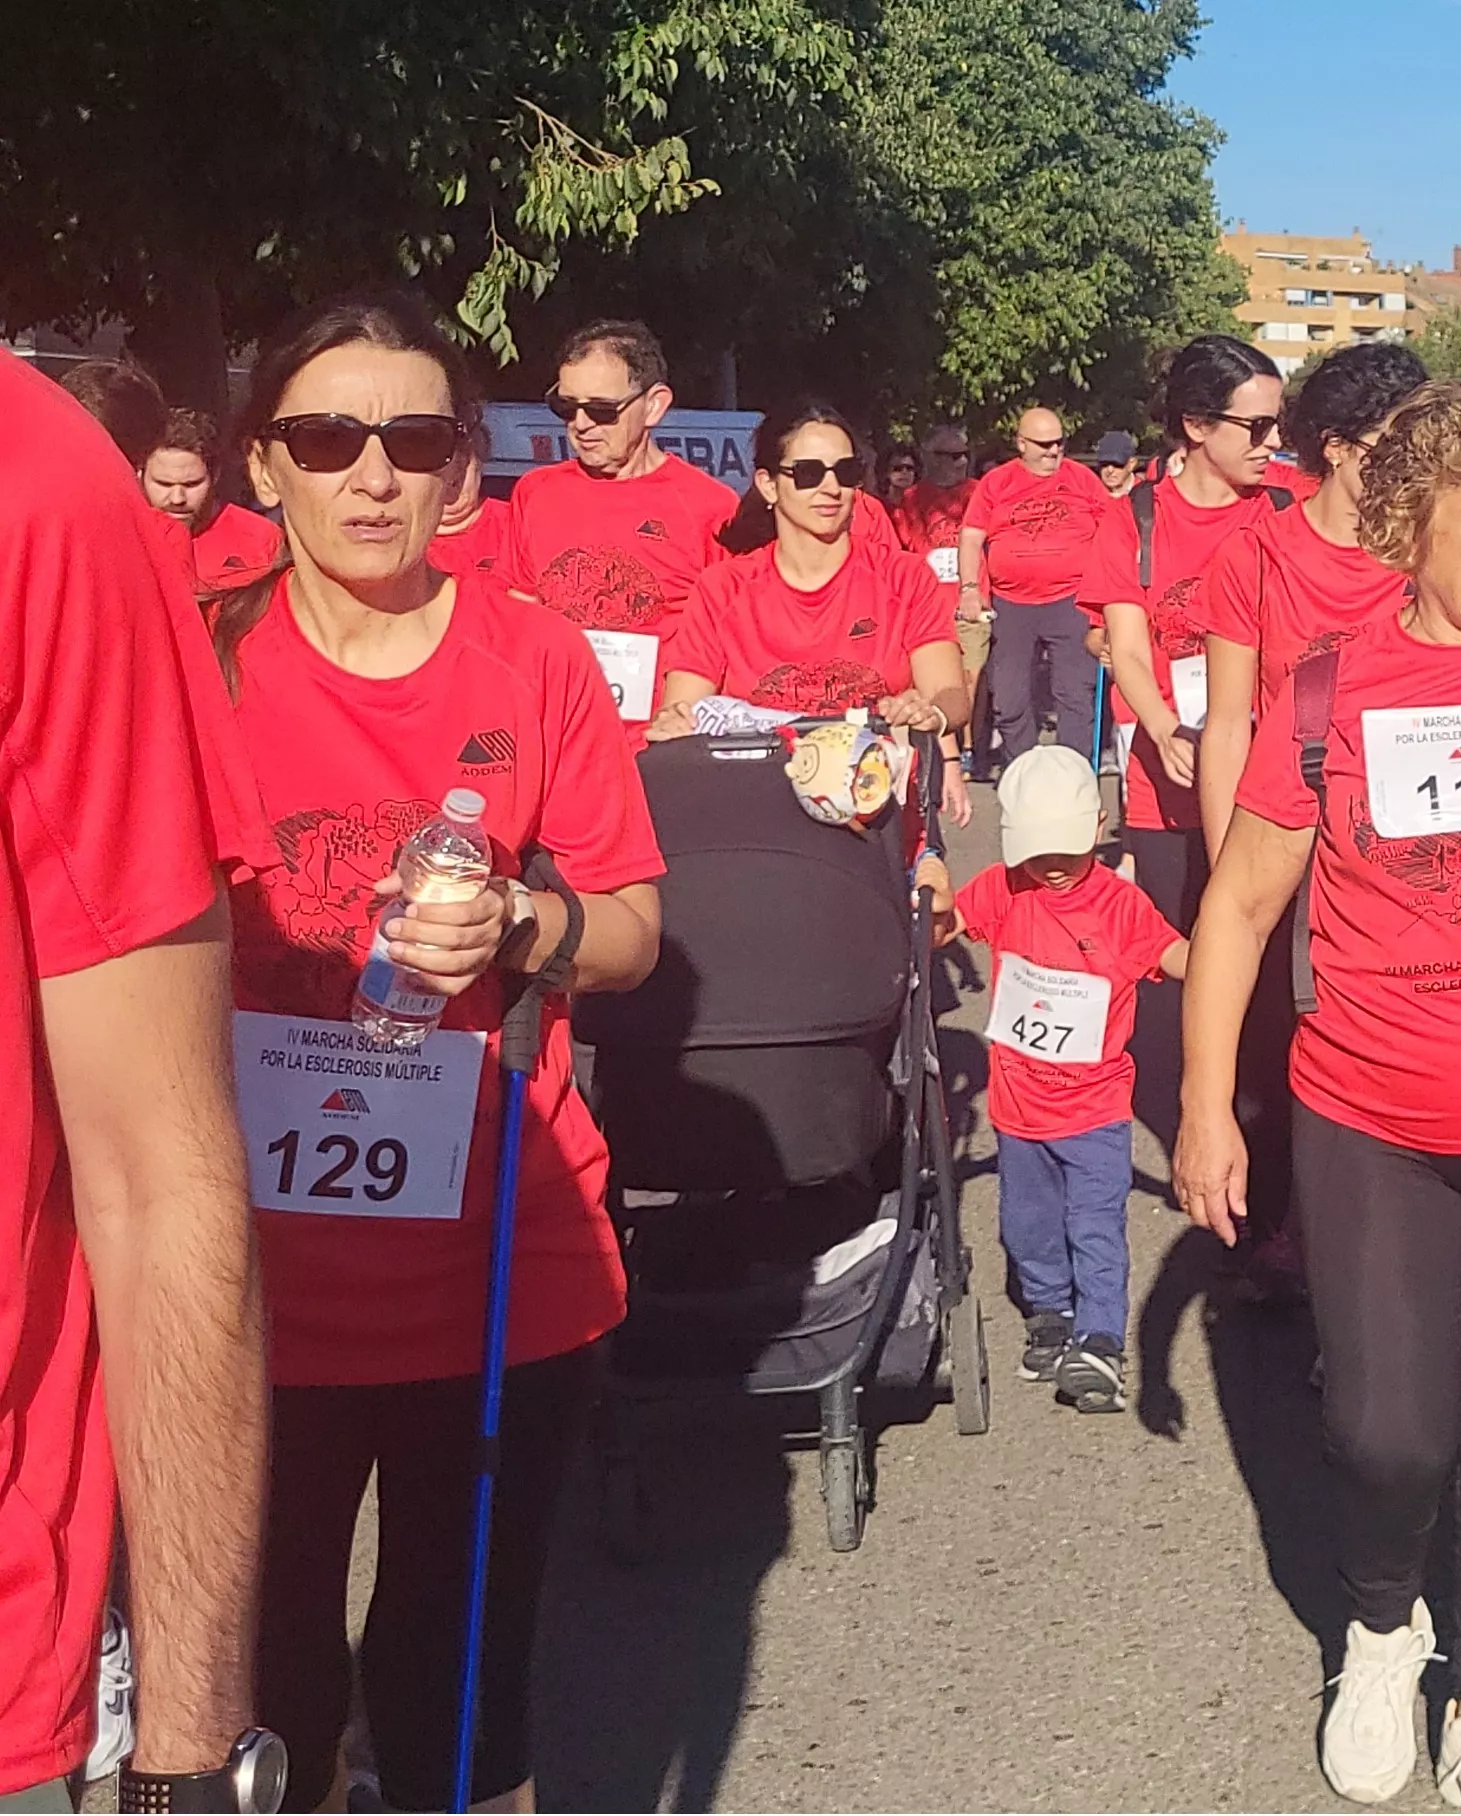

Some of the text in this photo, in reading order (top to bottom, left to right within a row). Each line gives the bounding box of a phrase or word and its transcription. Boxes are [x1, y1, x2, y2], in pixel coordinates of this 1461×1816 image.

[1423, 716, 1461, 728] MARCHA
[1396, 734, 1414, 744] POR
[1417, 733, 1428, 743] LA
[287, 1028, 300, 1044] IV
[302, 1030, 353, 1049] MARCHA
[1012, 1014, 1075, 1054] 427
[260, 1049, 443, 1082] POR LA ESCLEROSIS MÚLTIPLE
[267, 1129, 408, 1201] 129
